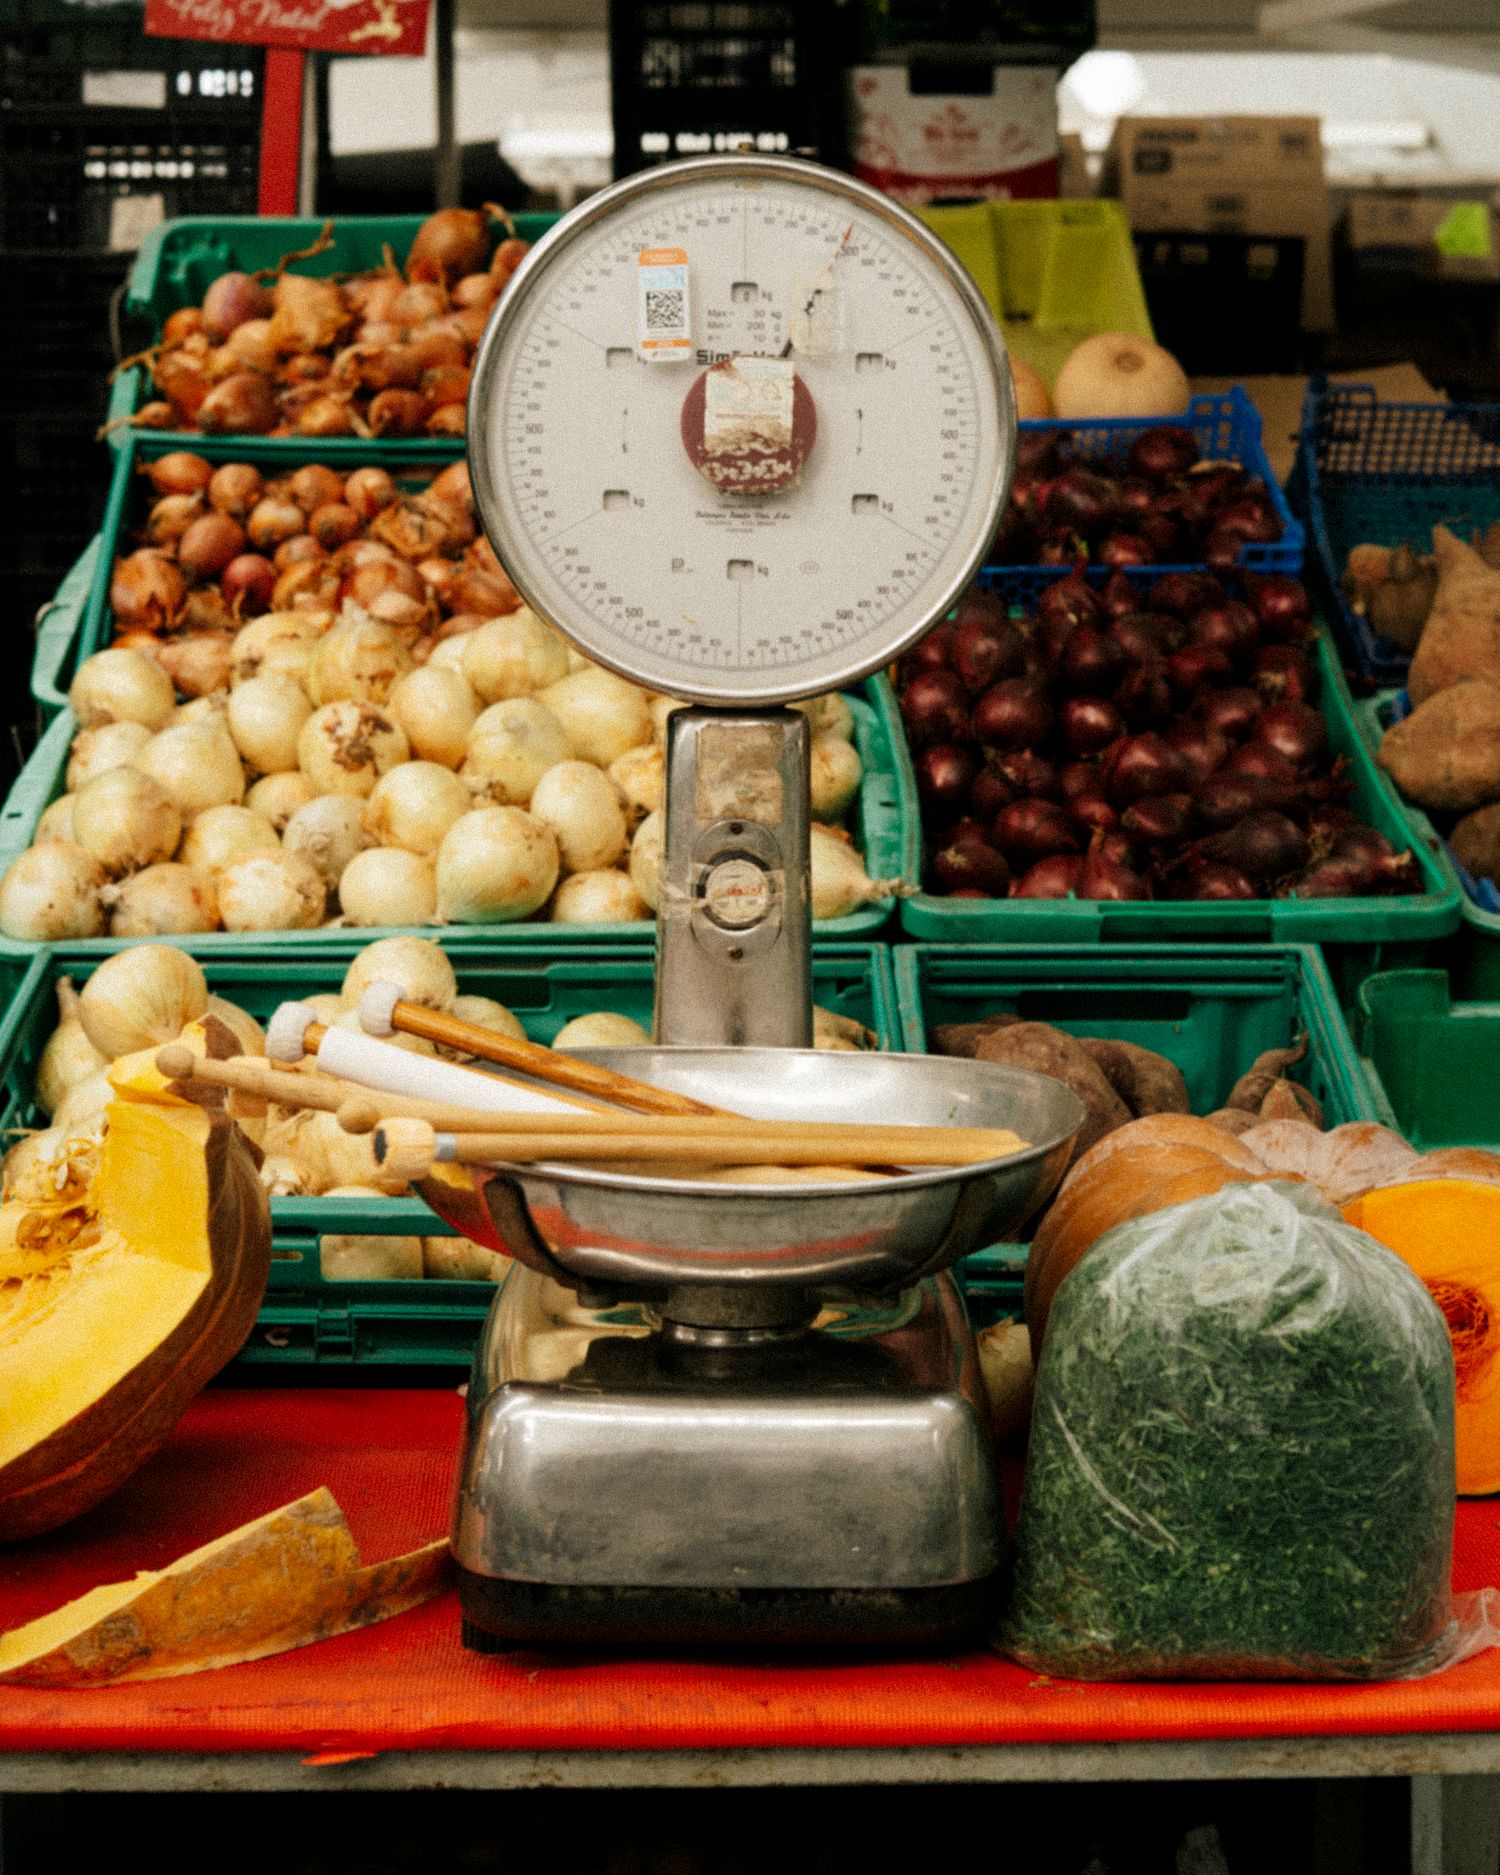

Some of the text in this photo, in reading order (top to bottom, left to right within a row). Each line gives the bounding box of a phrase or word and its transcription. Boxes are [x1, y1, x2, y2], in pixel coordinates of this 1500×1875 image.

[526, 424, 544, 434] 500
[940, 430, 959, 440] 500
[625, 607, 644, 618] 500
[836, 610, 854, 620] 500
